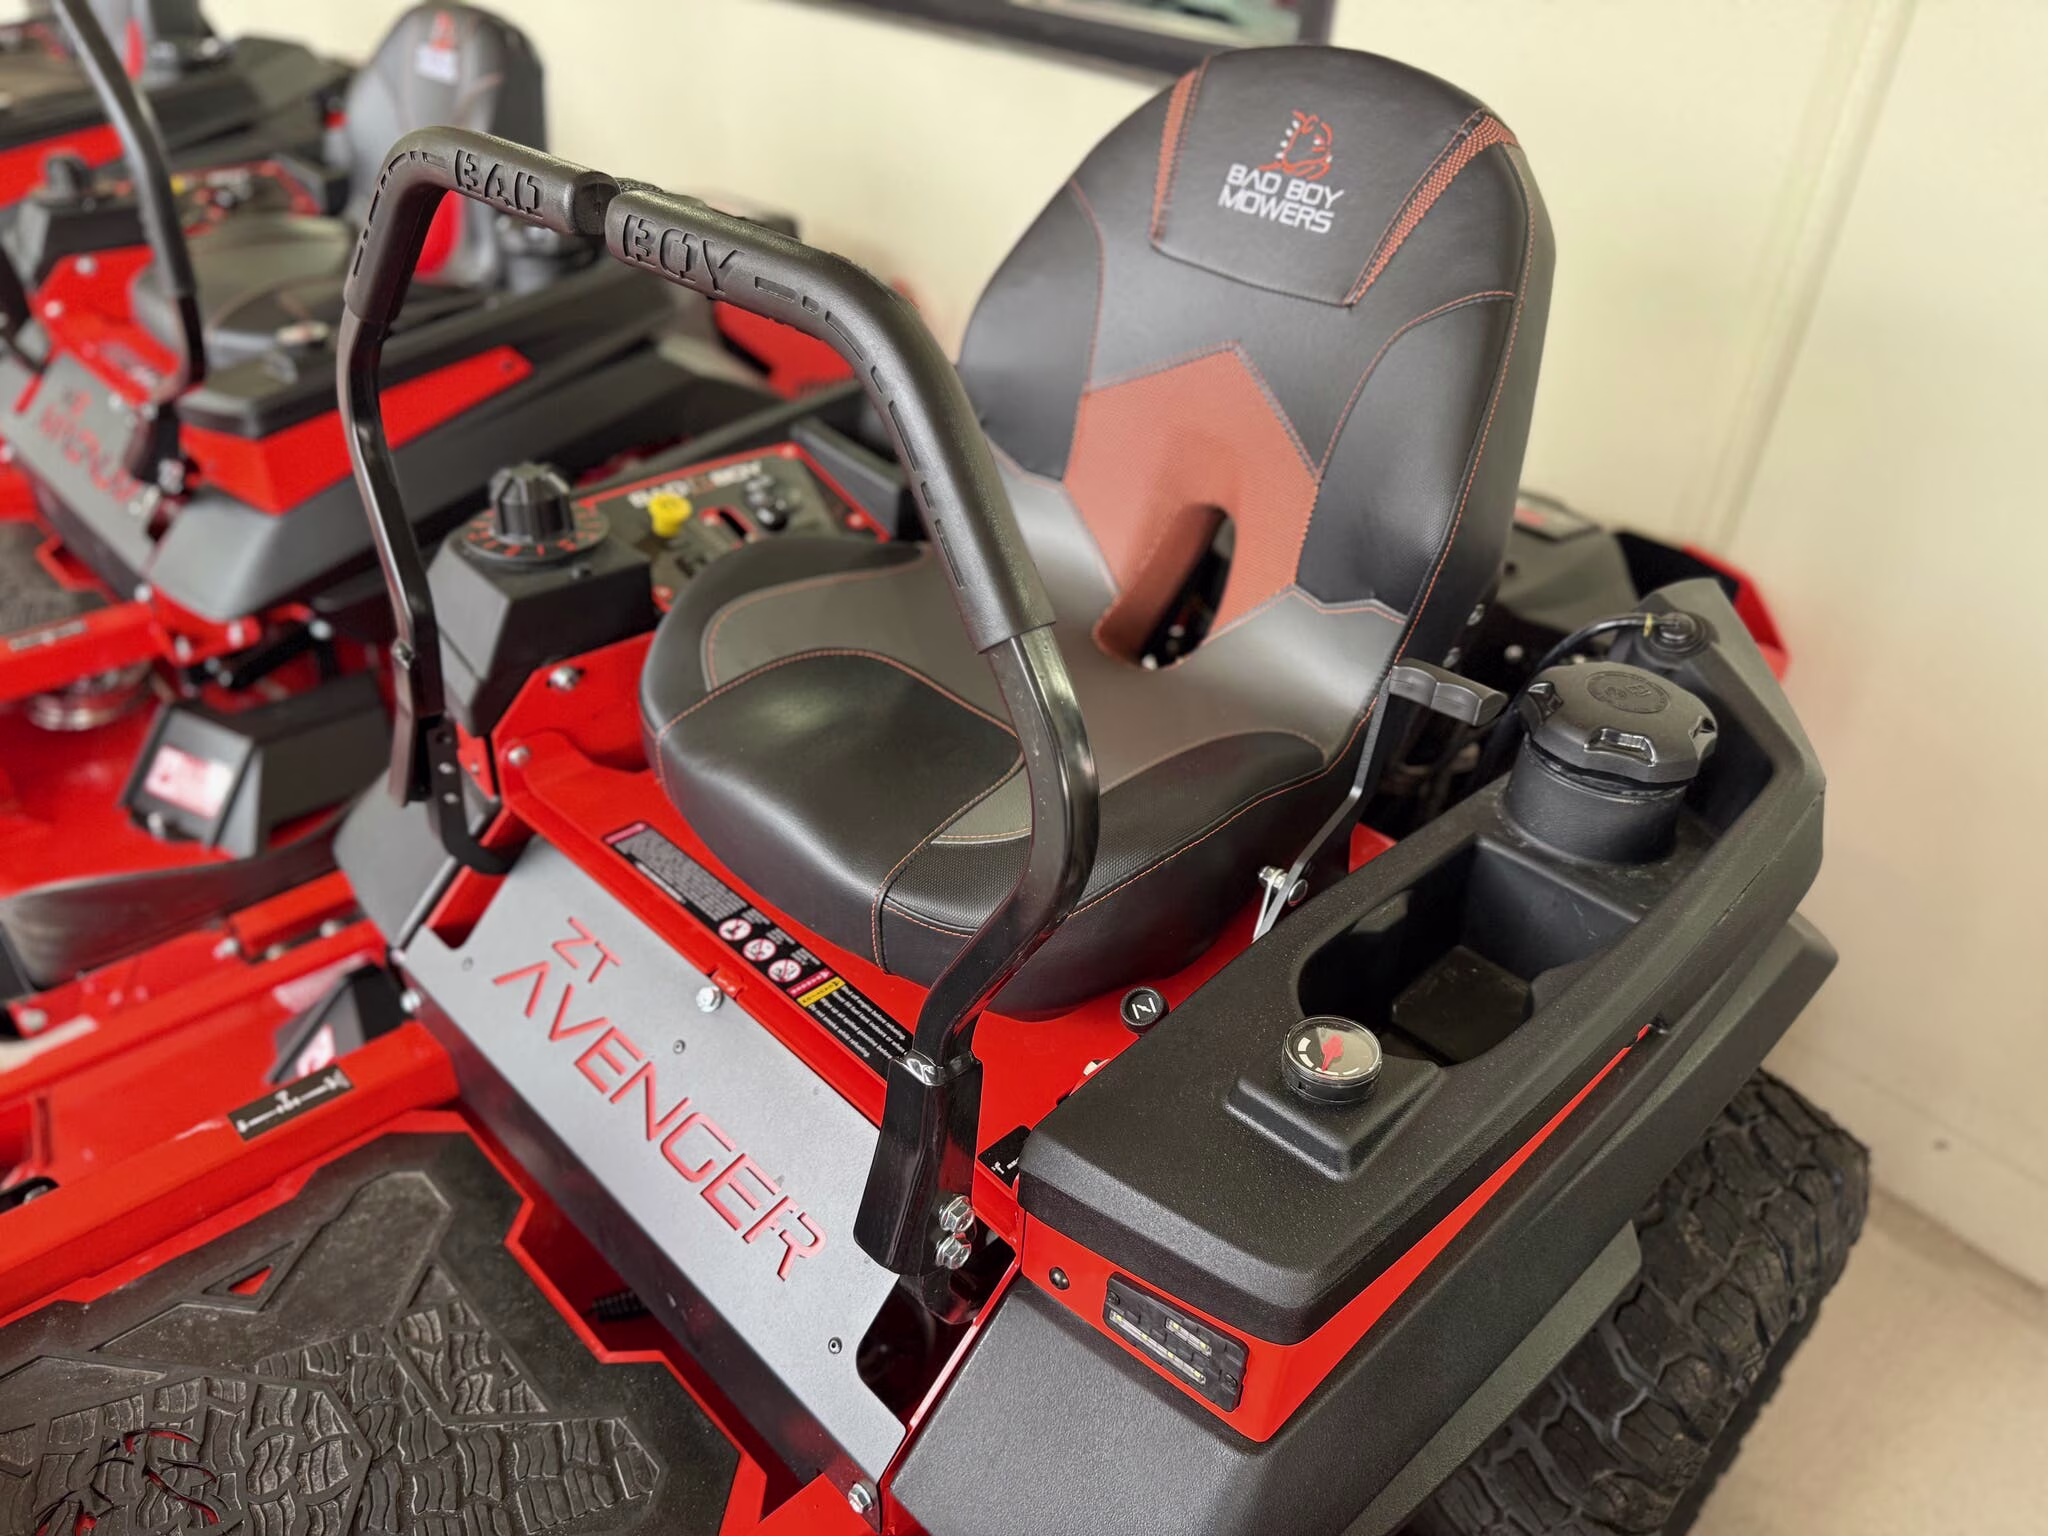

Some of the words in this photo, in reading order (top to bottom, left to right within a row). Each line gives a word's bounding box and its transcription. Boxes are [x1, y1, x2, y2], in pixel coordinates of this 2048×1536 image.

[1217, 183, 1335, 234] MOWERS
[1226, 163, 1282, 195] BAD
[1285, 178, 1344, 209] BOY
[454, 148, 544, 219] BAD
[622, 213, 746, 296] BOY
[552, 917, 622, 983] ZT
[492, 960, 827, 1282] AVENGER
